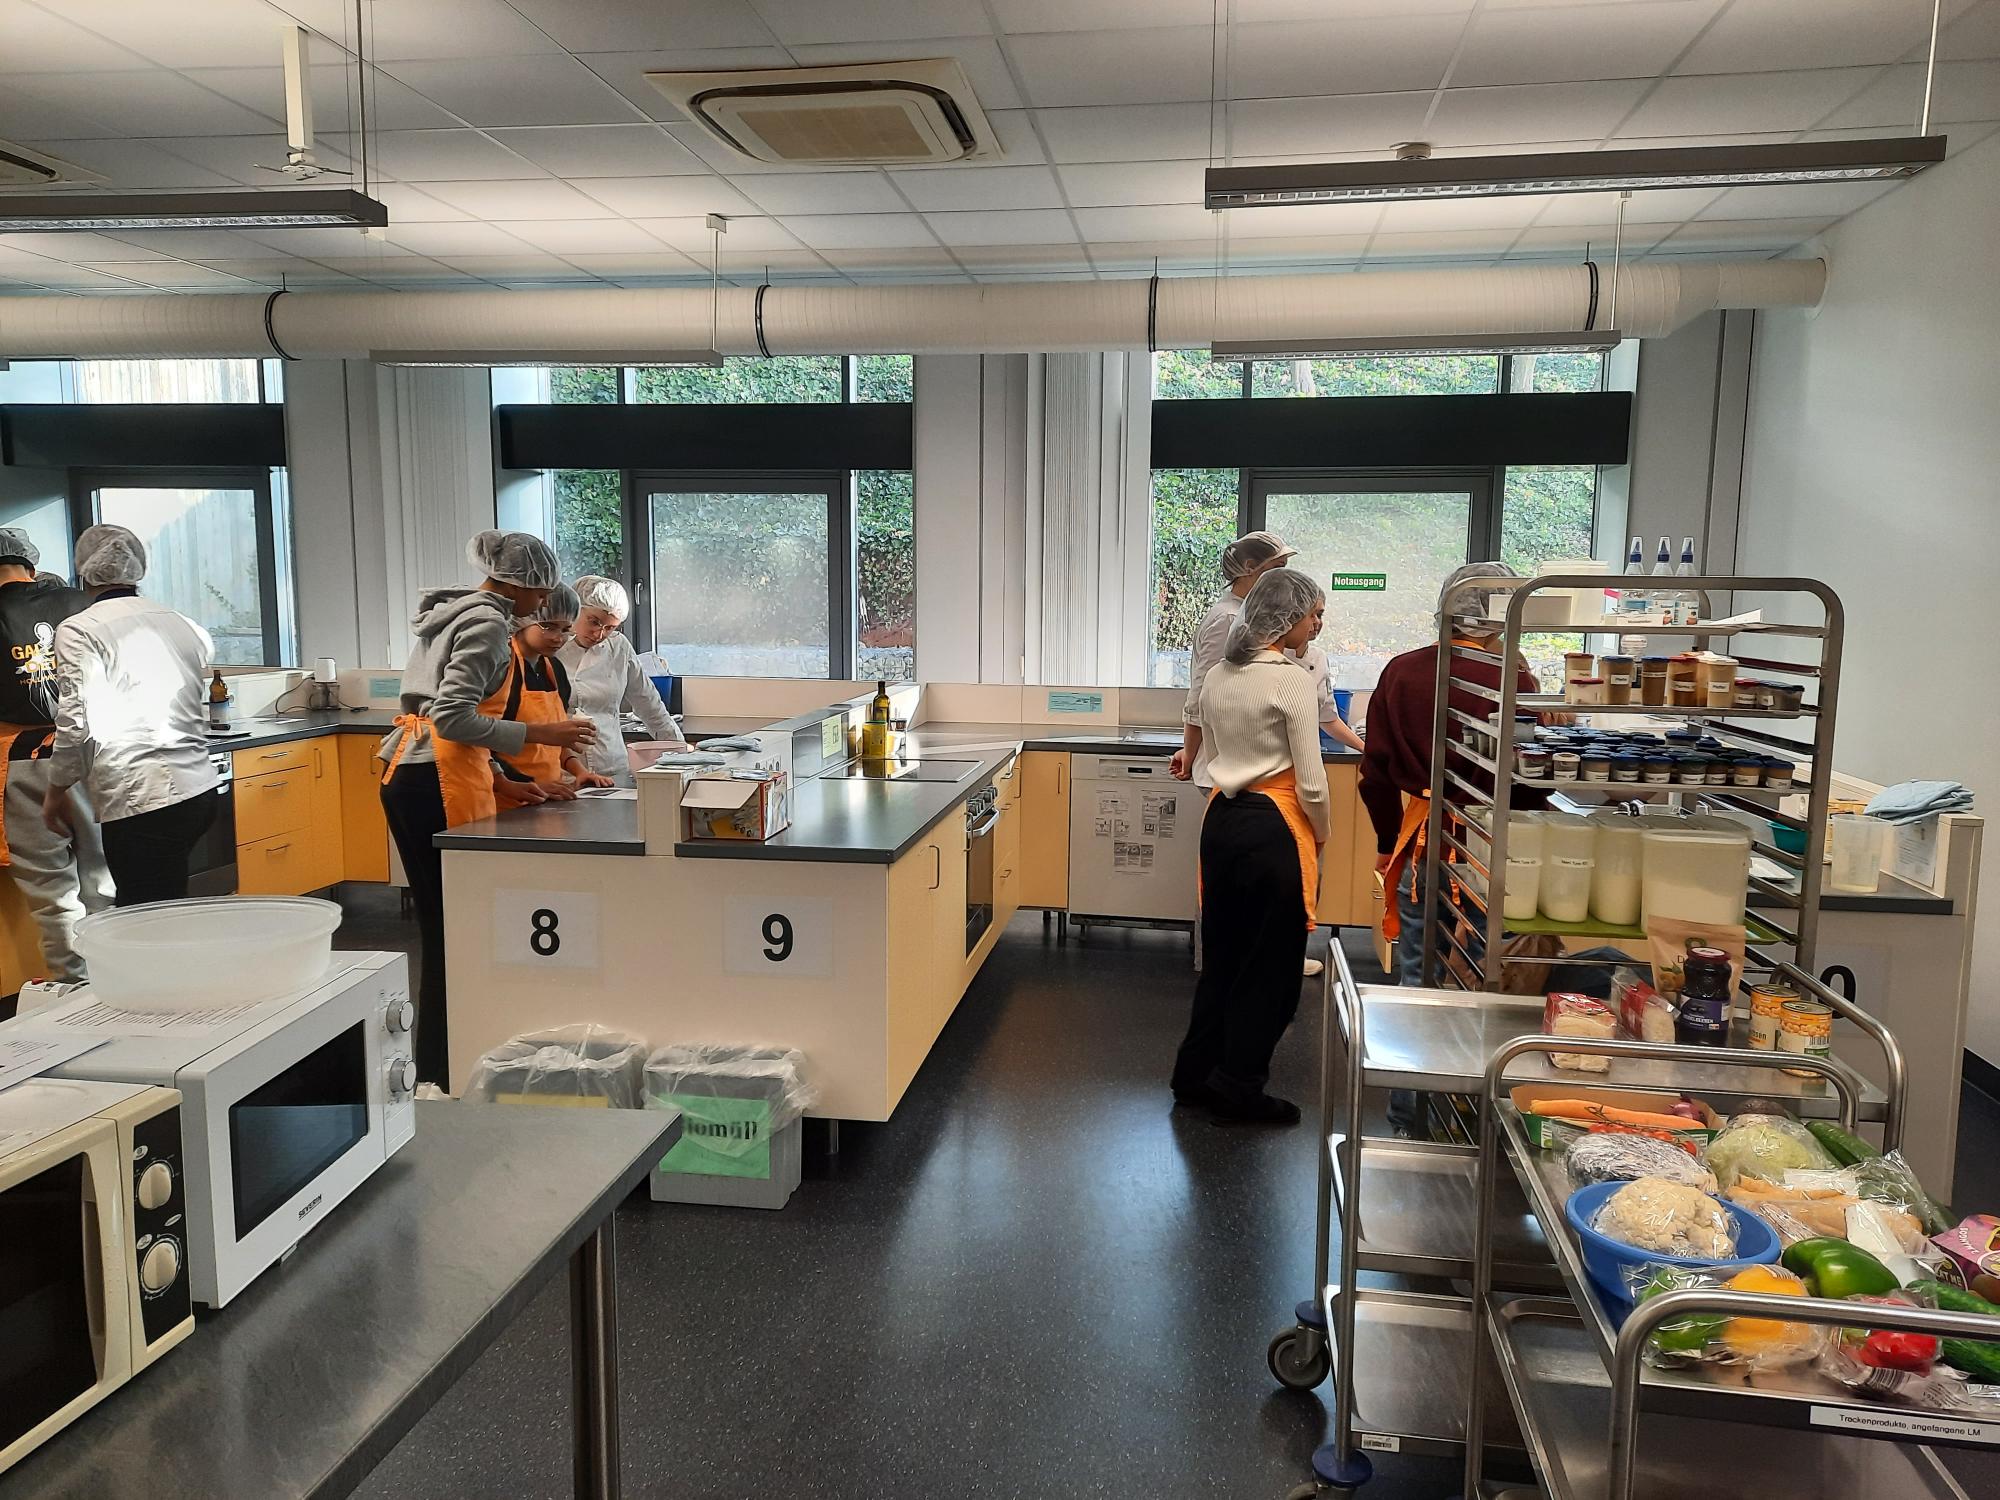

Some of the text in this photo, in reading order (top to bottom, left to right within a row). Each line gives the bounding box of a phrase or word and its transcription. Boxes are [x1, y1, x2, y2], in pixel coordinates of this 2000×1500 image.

[1334, 576, 1384, 588] Notausgang
[530, 908, 560, 956] 8
[761, 913, 794, 962] 9
[684, 1117, 758, 1140] iomüll
[1839, 1414, 1981, 1437] Trockenprodukte, angefangene LM
